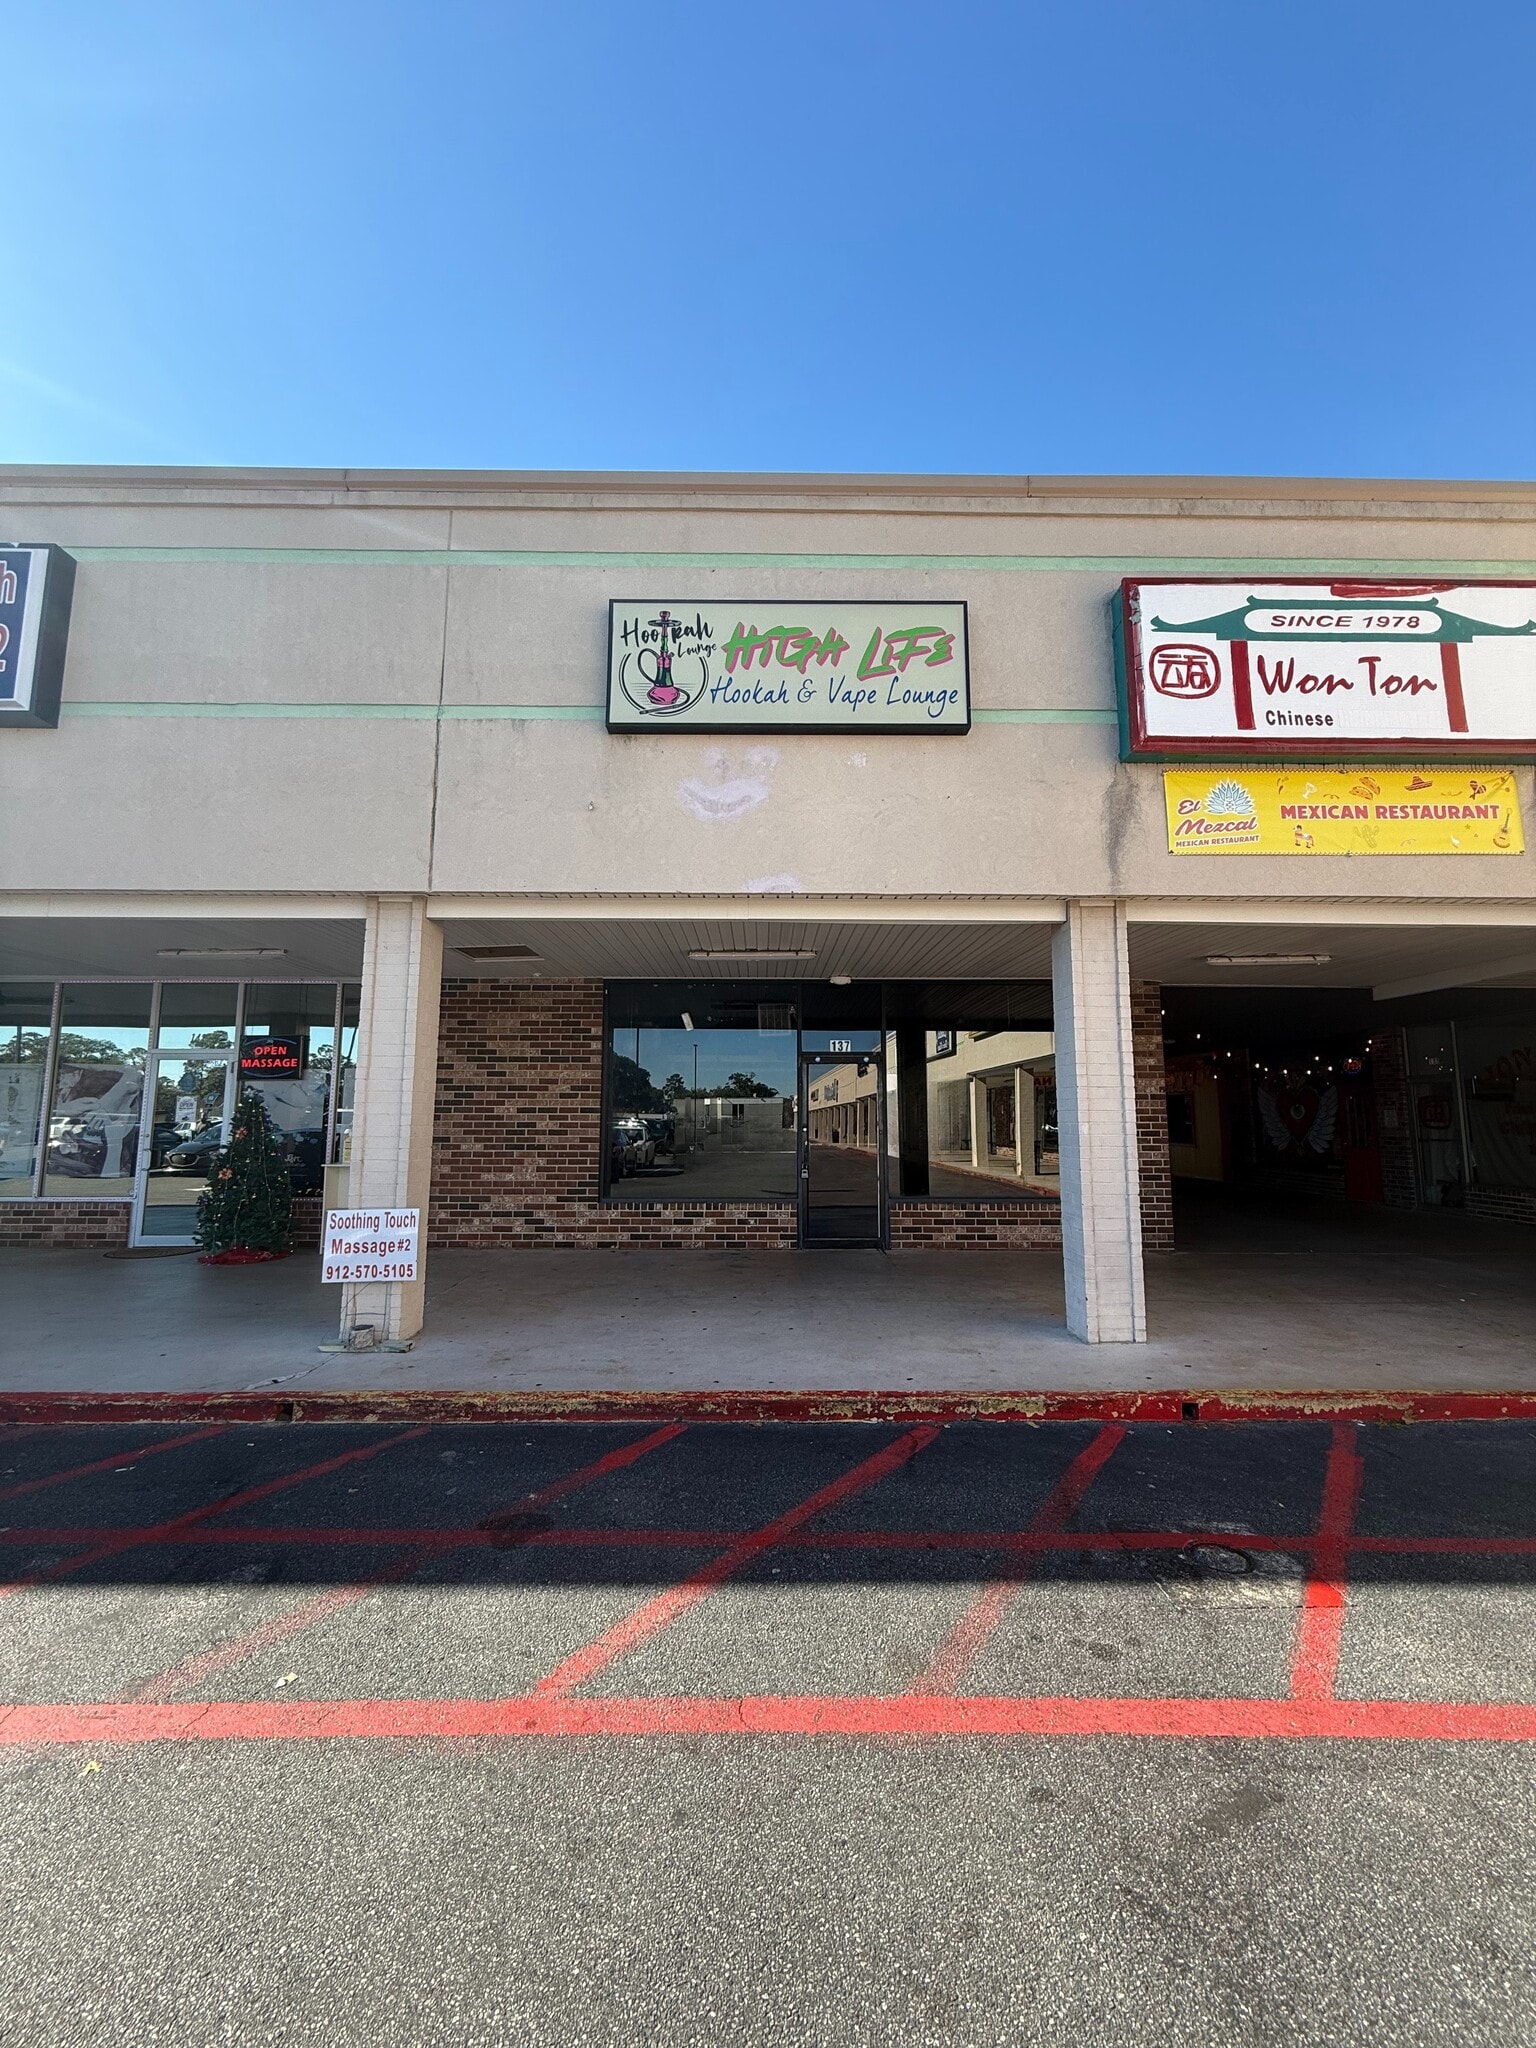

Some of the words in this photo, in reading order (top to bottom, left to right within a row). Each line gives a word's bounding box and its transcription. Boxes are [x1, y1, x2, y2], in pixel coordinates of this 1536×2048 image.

[1271, 614, 1353, 628] SINCE
[1362, 615, 1421, 629] 1978
[621, 612, 713, 648] Hookah
[677, 641, 717, 658] Lounge
[1257, 654, 1354, 696] Won
[1357, 656, 1438, 697] Ton
[710, 675, 789, 705] Hookah
[797, 678, 817, 703] &
[829, 677, 878, 712] Vape
[885, 675, 959, 718] Lounge
[1265, 709, 1335, 727] Chinese
[1178, 799, 1201, 815] El
[1280, 805, 1369, 820] MEXICAN
[1375, 804, 1500, 820] RESTAURANT
[1175, 816, 1258, 836] Mezcal
[1175, 839, 1210, 848] MEXICAN
[1211, 835, 1260, 845] RESTAURANT
[254, 1046, 287, 1055] OPEN
[831, 1040, 850, 1052] 137
[241, 1058, 298, 1068] MASSAGE
[329, 1212, 380, 1233] Soothing
[384, 1211, 416, 1228] Touch
[326, 1263, 413, 1279] 912-570-5105
